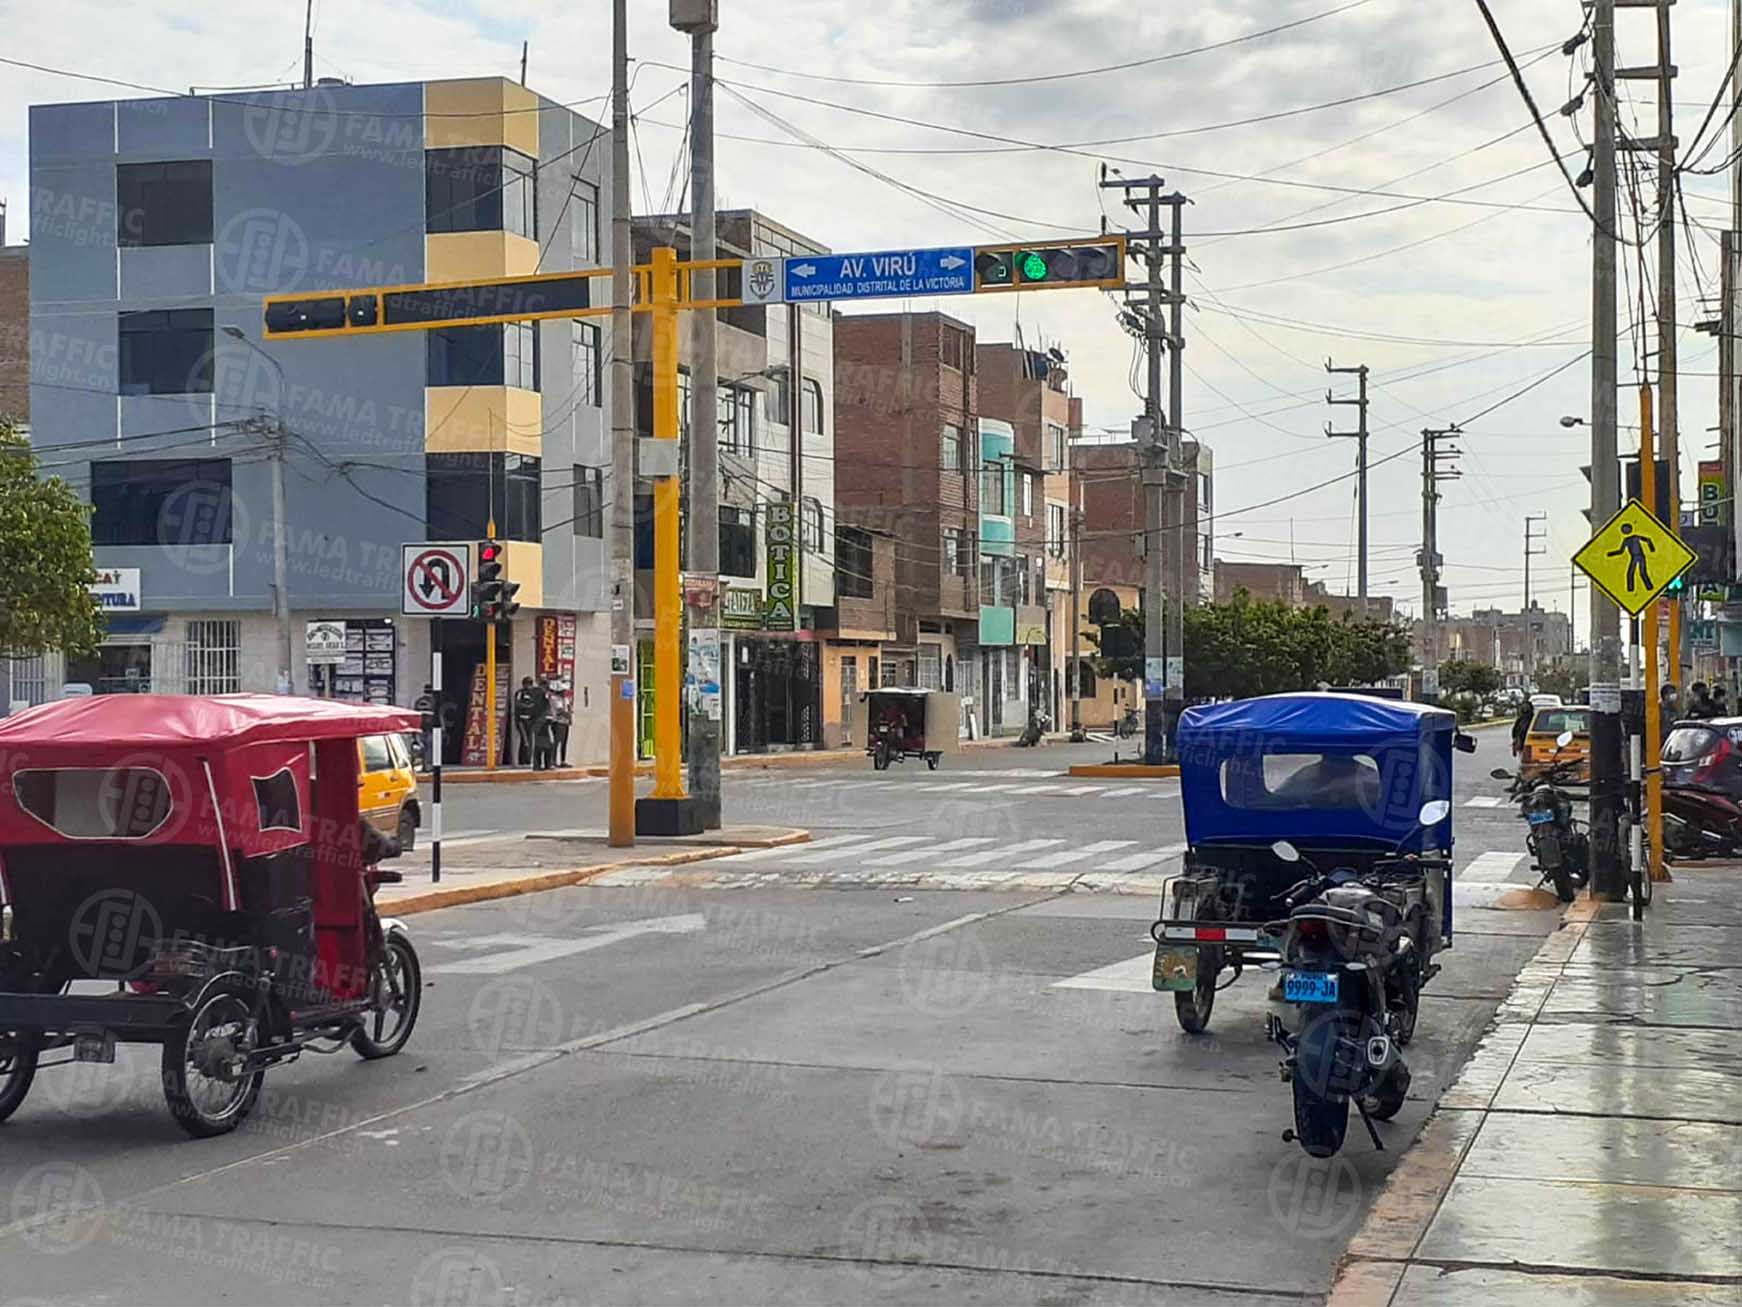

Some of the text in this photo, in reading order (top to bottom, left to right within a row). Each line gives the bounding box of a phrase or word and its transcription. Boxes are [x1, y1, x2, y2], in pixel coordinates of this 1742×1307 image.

[840, 253, 917, 279] AV. VIRÚ
[791, 277, 965, 297] MUNICIPALIDAD DISTRITAL DE LA VICTORIA
[769, 505, 793, 618] BOTICA
[543, 618, 556, 672] DENTAL
[466, 663, 487, 750] DENTAL
[1287, 981, 1336, 998] 9999-JA
